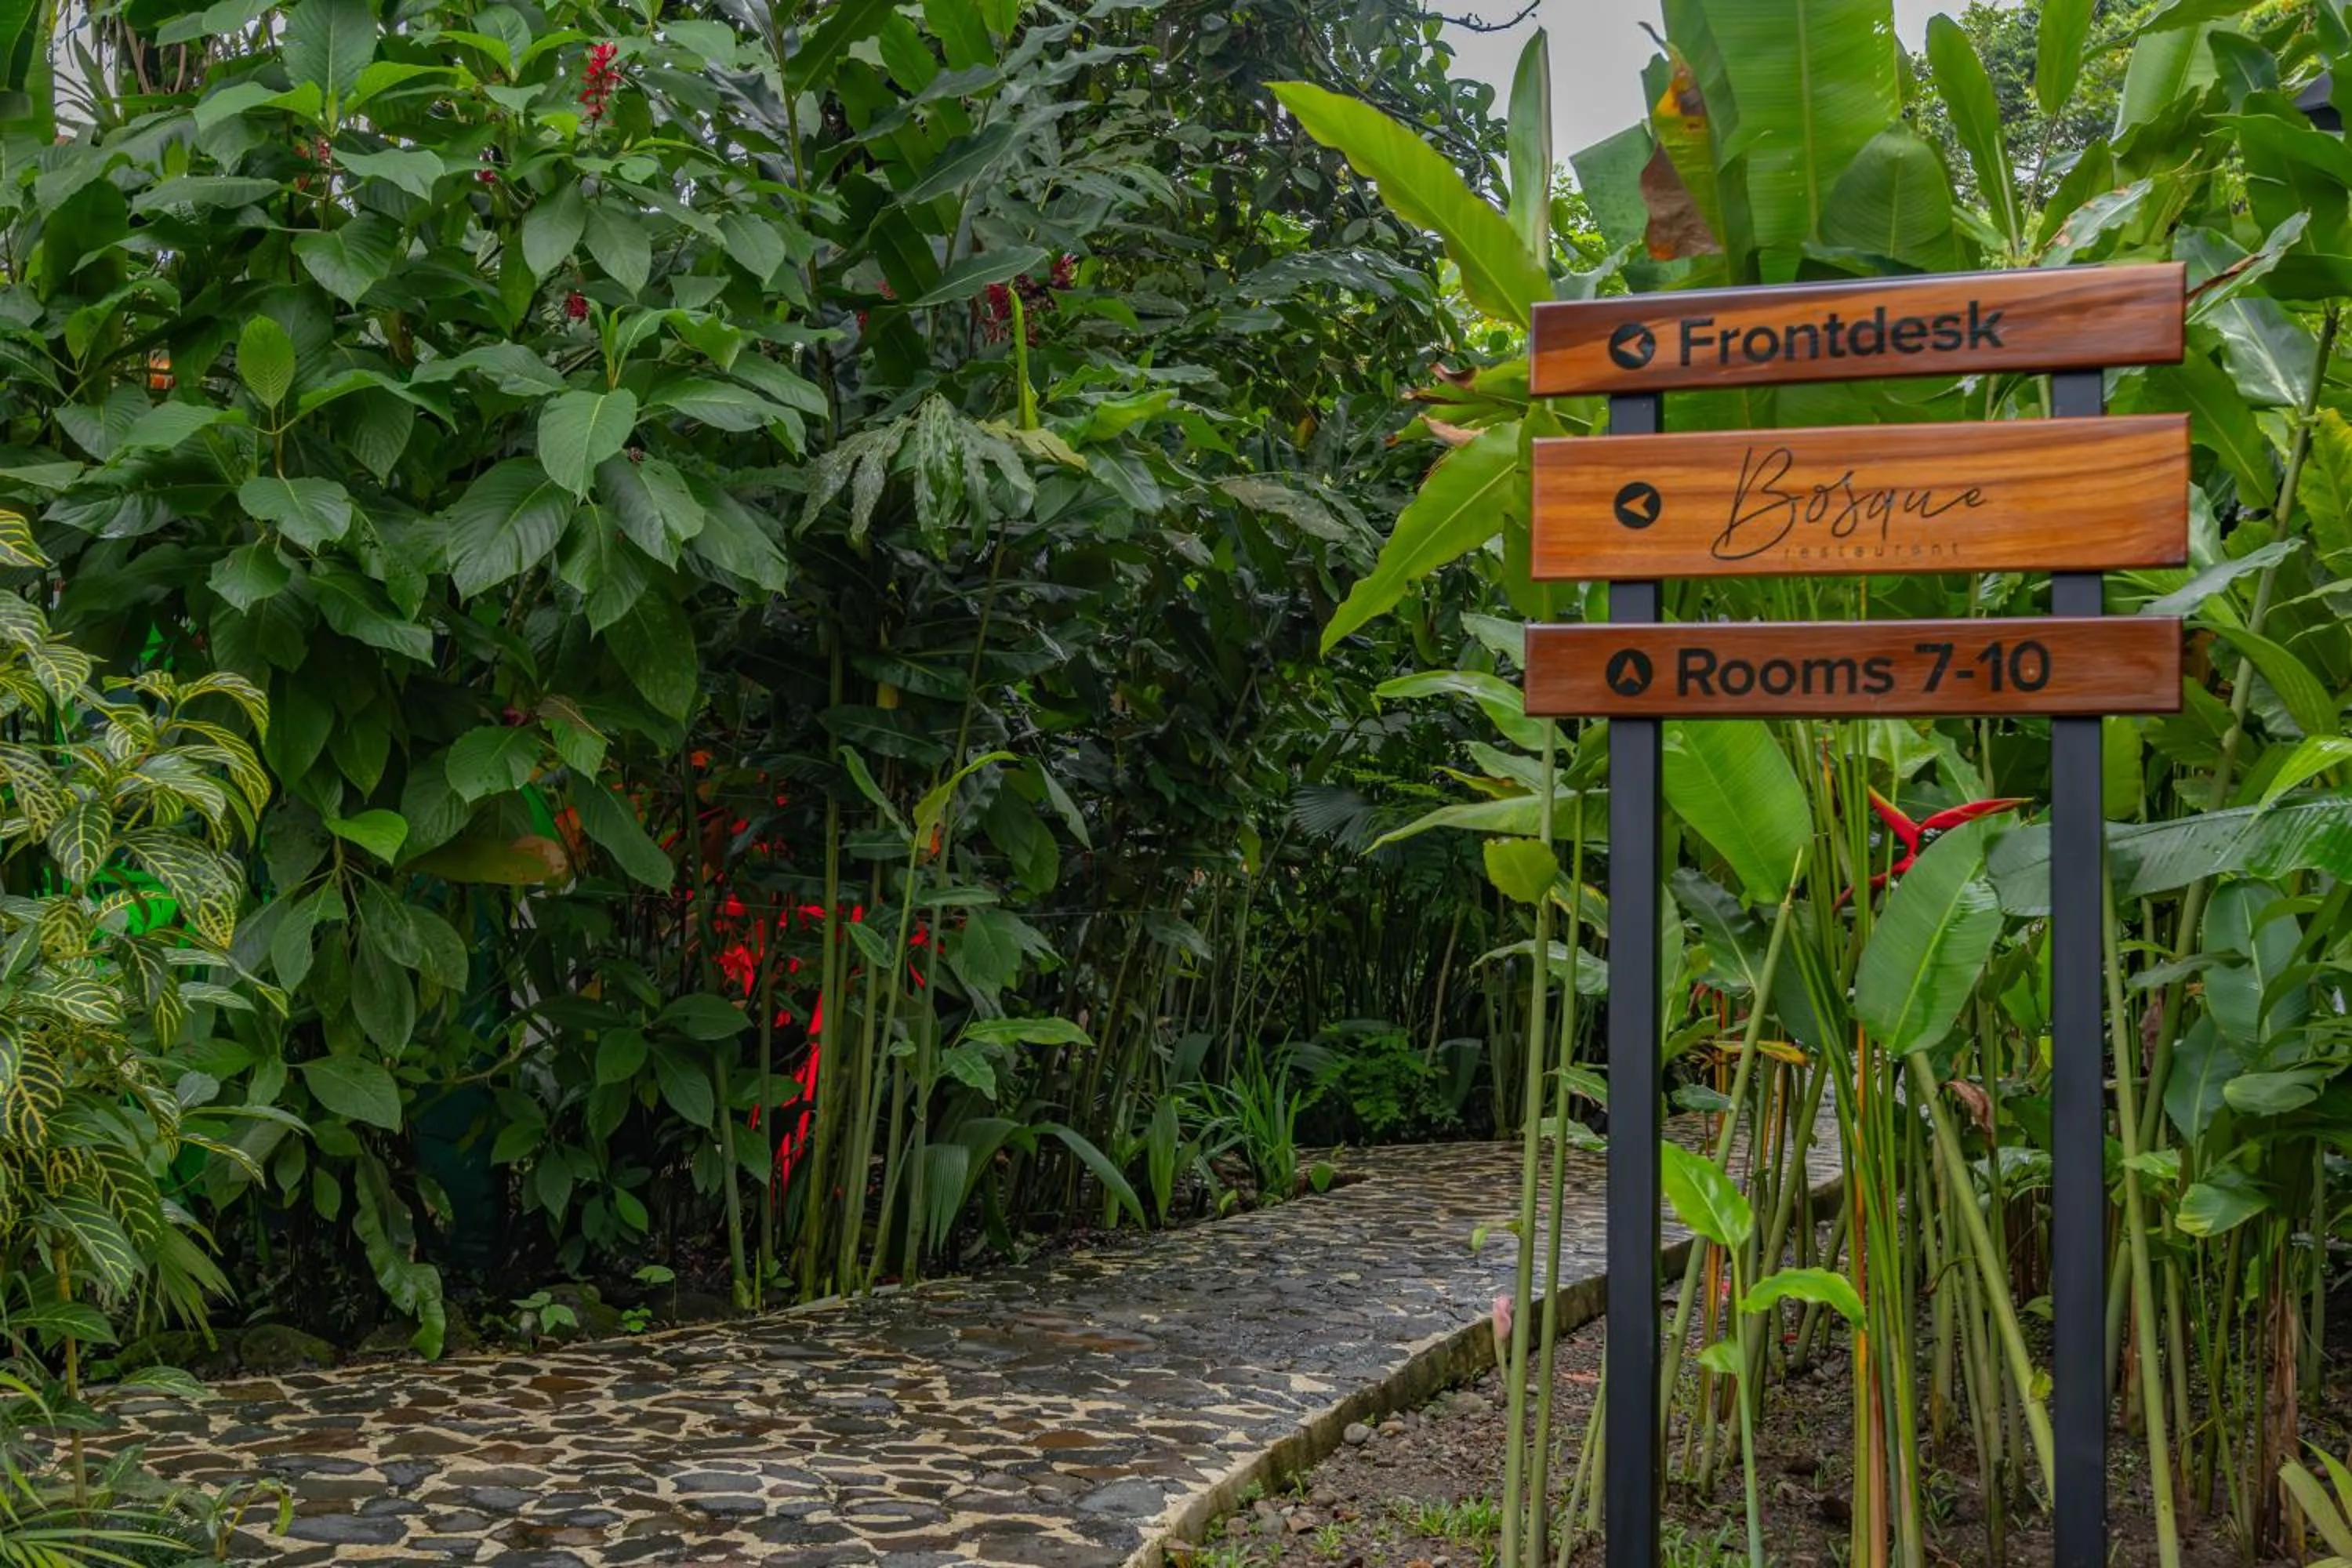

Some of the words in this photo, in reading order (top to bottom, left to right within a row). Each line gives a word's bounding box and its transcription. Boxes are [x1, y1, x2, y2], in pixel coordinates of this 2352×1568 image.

[1679, 301, 2005, 365] Frontdesk
[1711, 447, 1987, 560] Bosque
[1678, 648, 1894, 695] Rooms
[1915, 640, 2051, 692] 7-10
